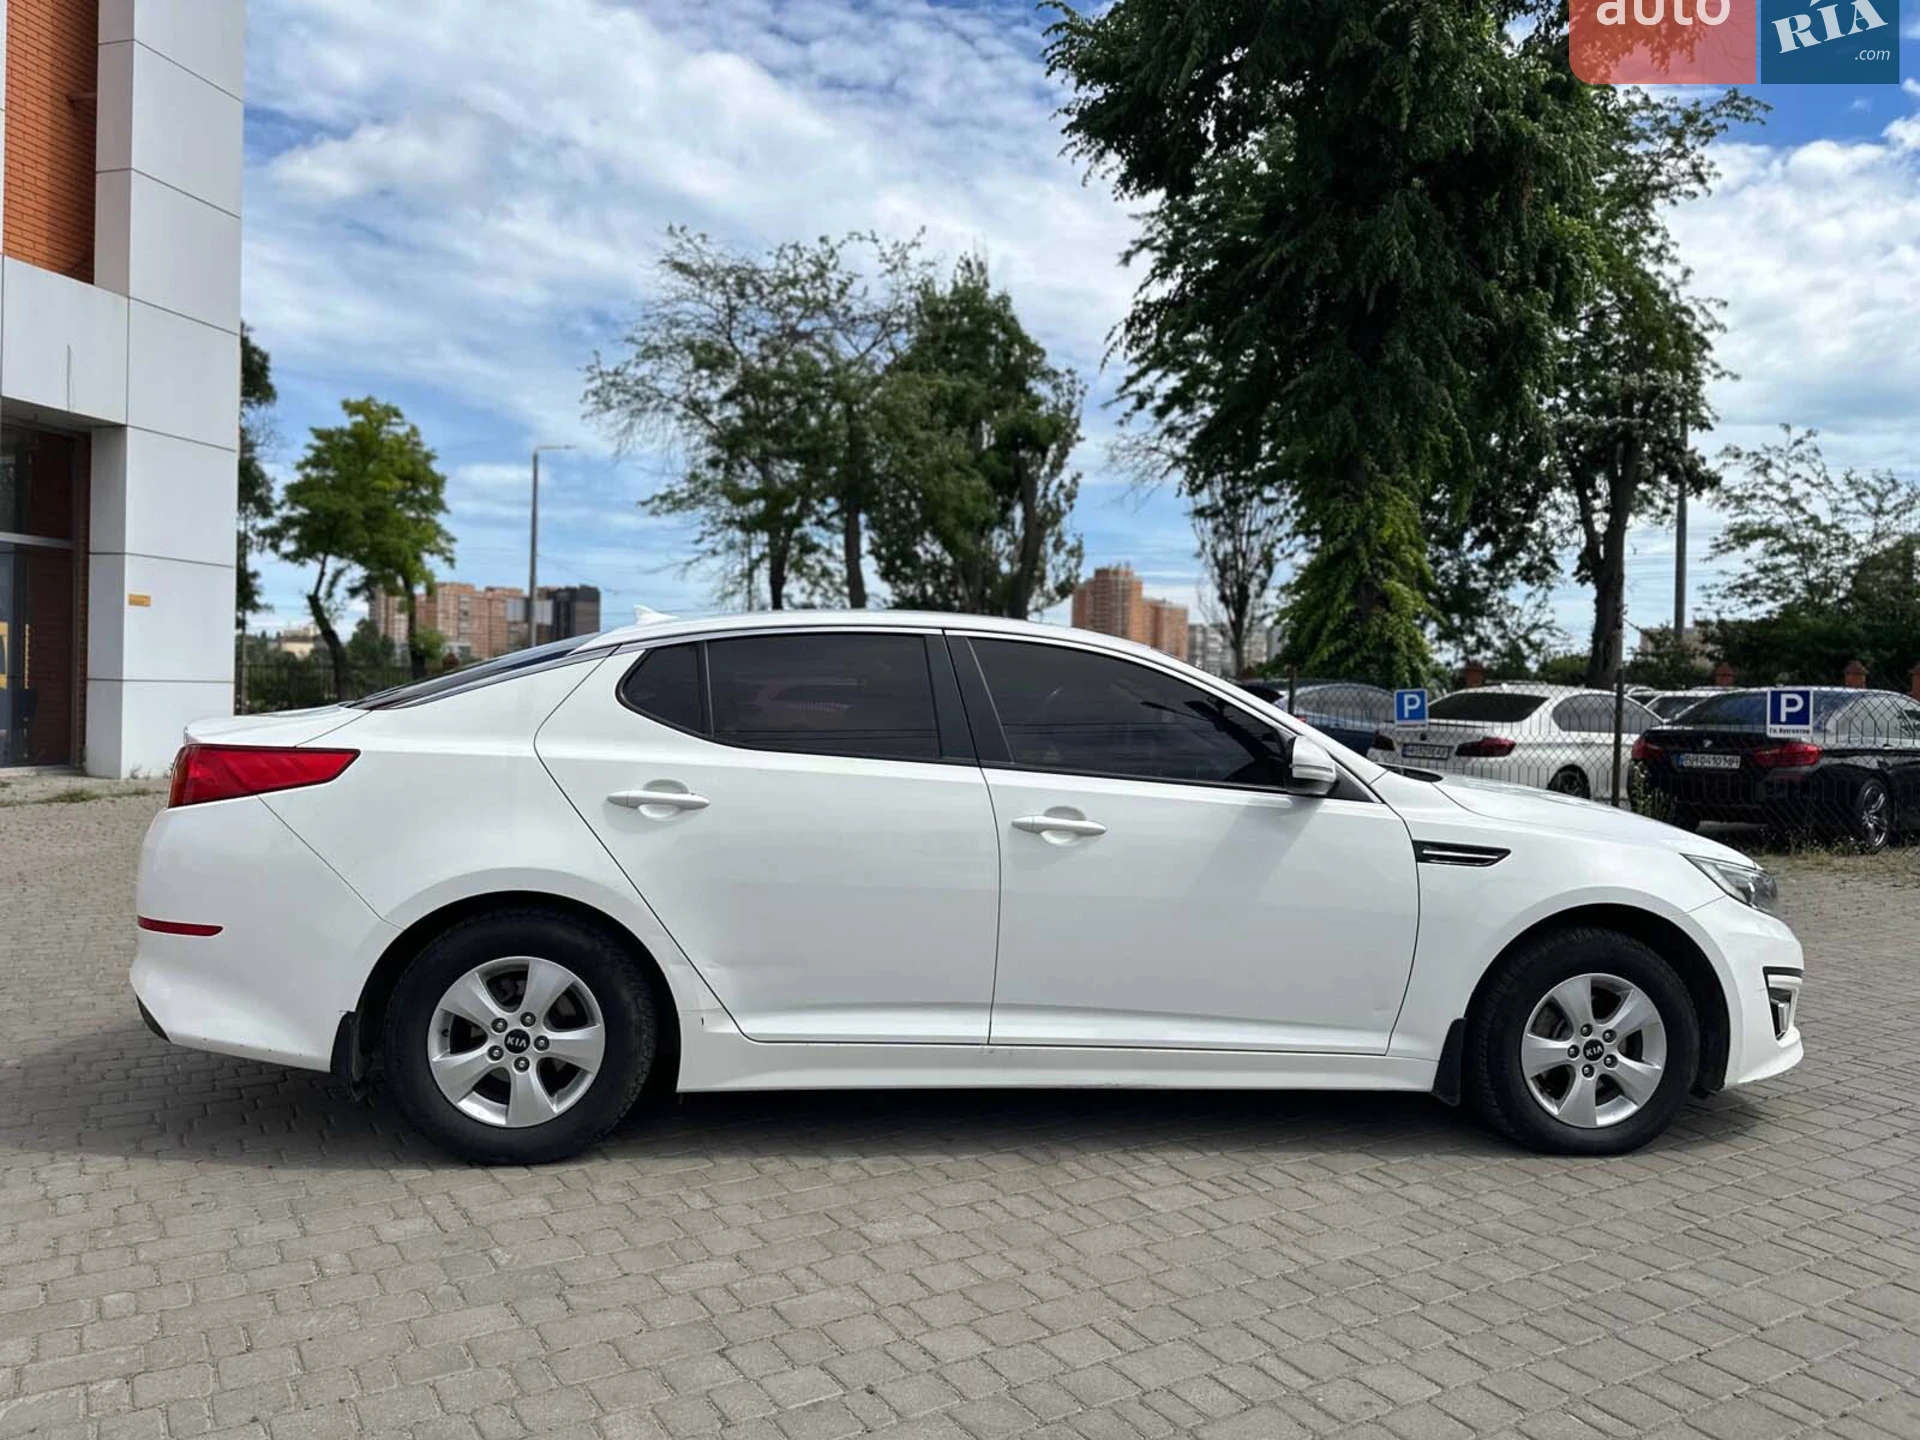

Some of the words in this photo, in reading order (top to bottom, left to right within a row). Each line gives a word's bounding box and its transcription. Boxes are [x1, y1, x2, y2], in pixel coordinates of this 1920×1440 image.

[1404, 694, 1421, 718] P
[1780, 693, 1804, 722] P
[507, 1036, 527, 1048] KIA
[1585, 1045, 1603, 1057] KIA
